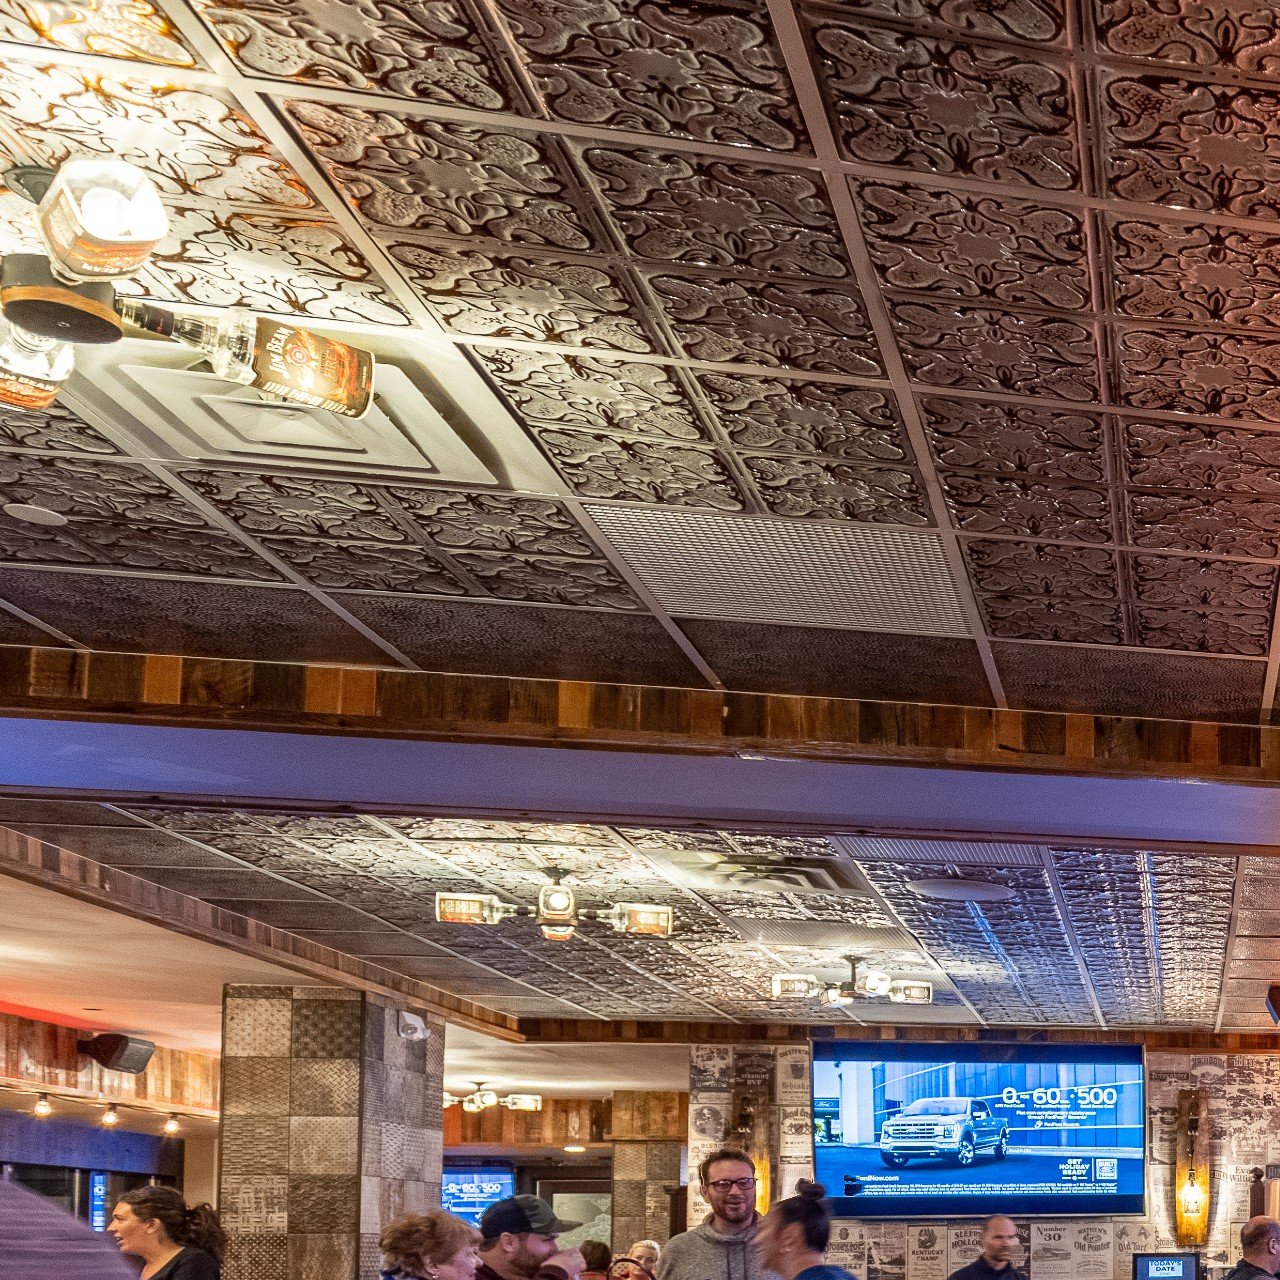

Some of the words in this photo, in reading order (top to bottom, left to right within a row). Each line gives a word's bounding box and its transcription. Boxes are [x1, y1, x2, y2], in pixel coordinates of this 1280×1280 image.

[266, 327, 296, 354] BEAM
[269, 351, 292, 380] JIM
[323, 349, 338, 379] FIRE
[782, 1081, 809, 1090] Whiske
[1033, 1087, 1060, 1105] 60
[1036, 1226, 1066, 1236] Number
[1043, 1233, 1061, 1241] 30
[952, 1240, 980, 1248] HOLLO
[1074, 1241, 1086, 1251] Old
[1087, 1241, 1111, 1252] Pointer
[1118, 1242, 1131, 1252] Old
